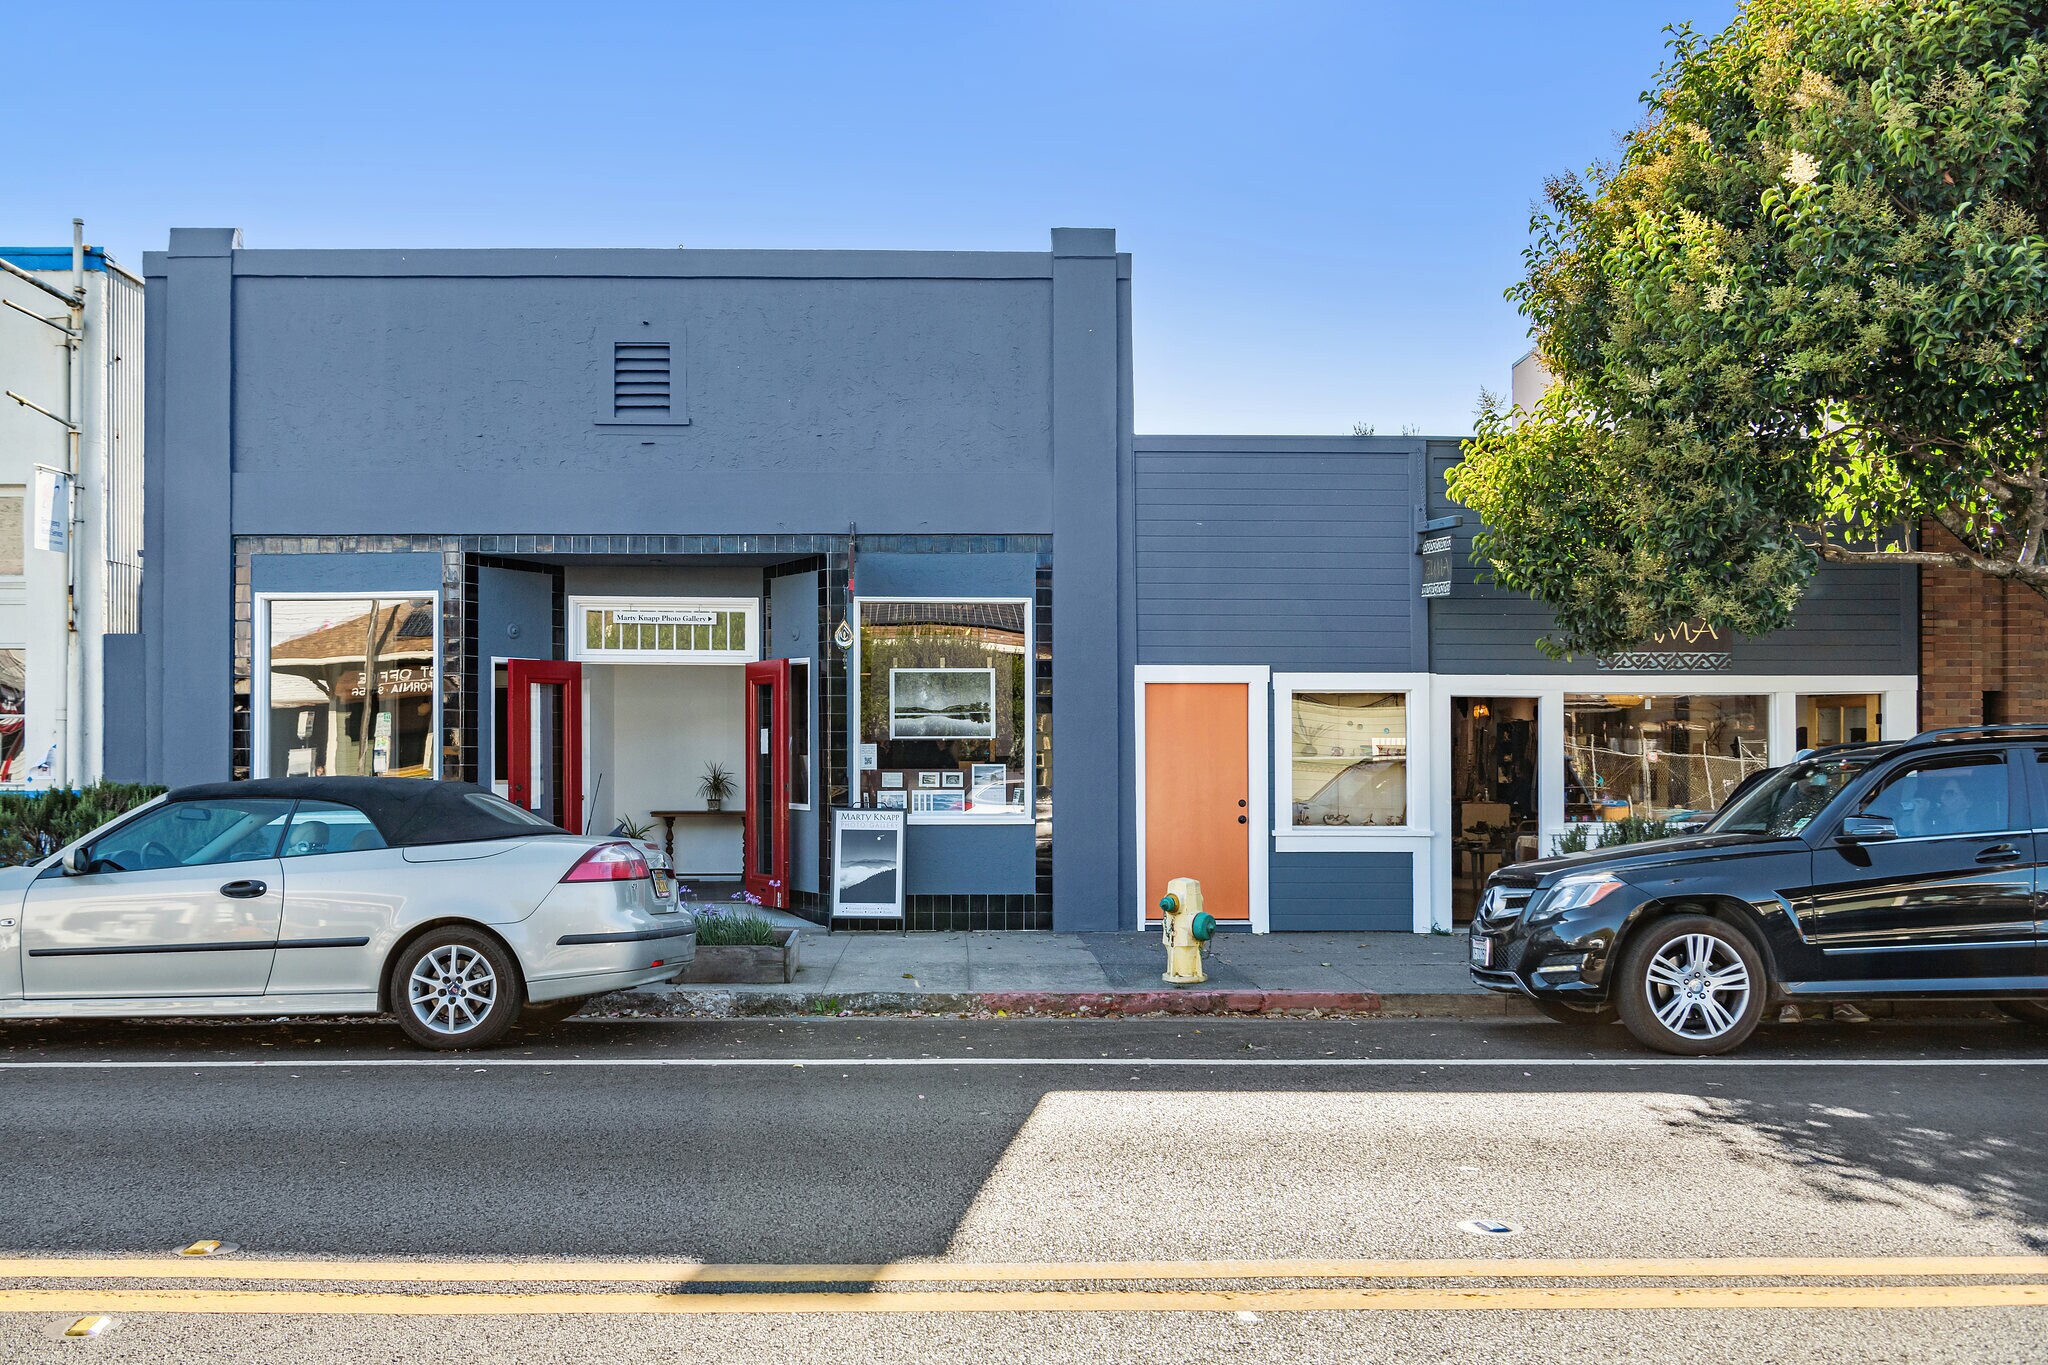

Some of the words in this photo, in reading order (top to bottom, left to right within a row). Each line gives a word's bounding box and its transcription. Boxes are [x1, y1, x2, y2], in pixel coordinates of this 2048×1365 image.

[616, 614, 636, 622] Marty
[638, 614, 660, 623] Knapp
[682, 615, 707, 623] Gallery
[841, 812, 872, 821] MARTY
[873, 813, 900, 821] KNAPP
